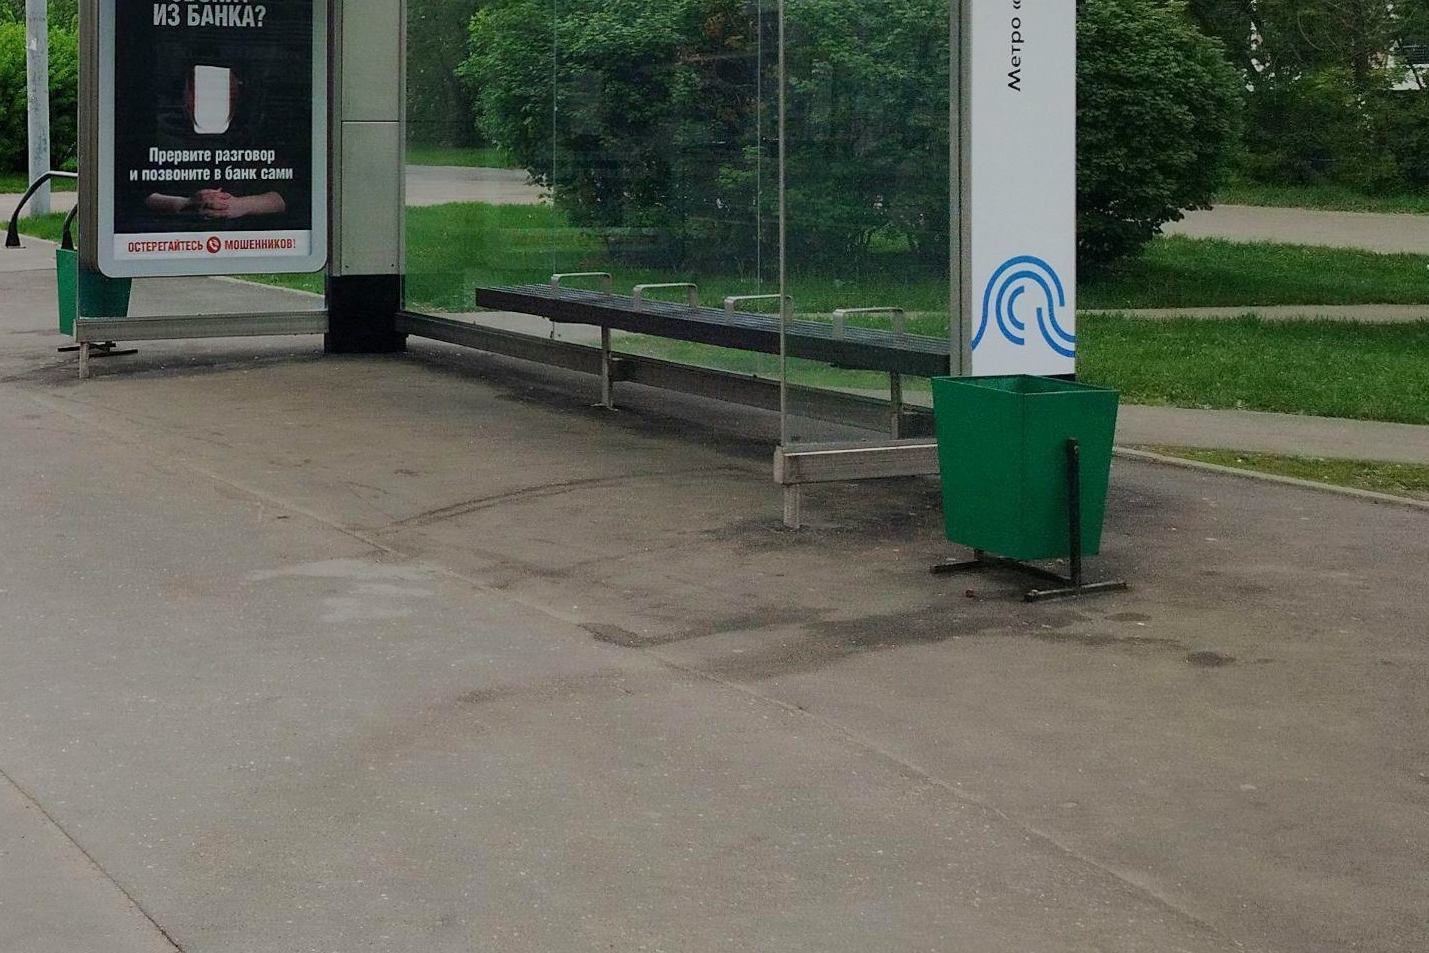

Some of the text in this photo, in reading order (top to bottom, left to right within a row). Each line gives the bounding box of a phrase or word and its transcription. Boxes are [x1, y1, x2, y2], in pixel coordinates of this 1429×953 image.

[153, 3, 267, 27] ИЗ БАНКА?
[1007, 16, 1024, 91] Метро
[149, 147, 275, 165] Прервите разговор
[129, 165, 293, 181] и позвоните в банк сами
[128, 238, 296, 253] ОСТЕРЕГАЙТЕСЬ МОШЕННИКОВ!
